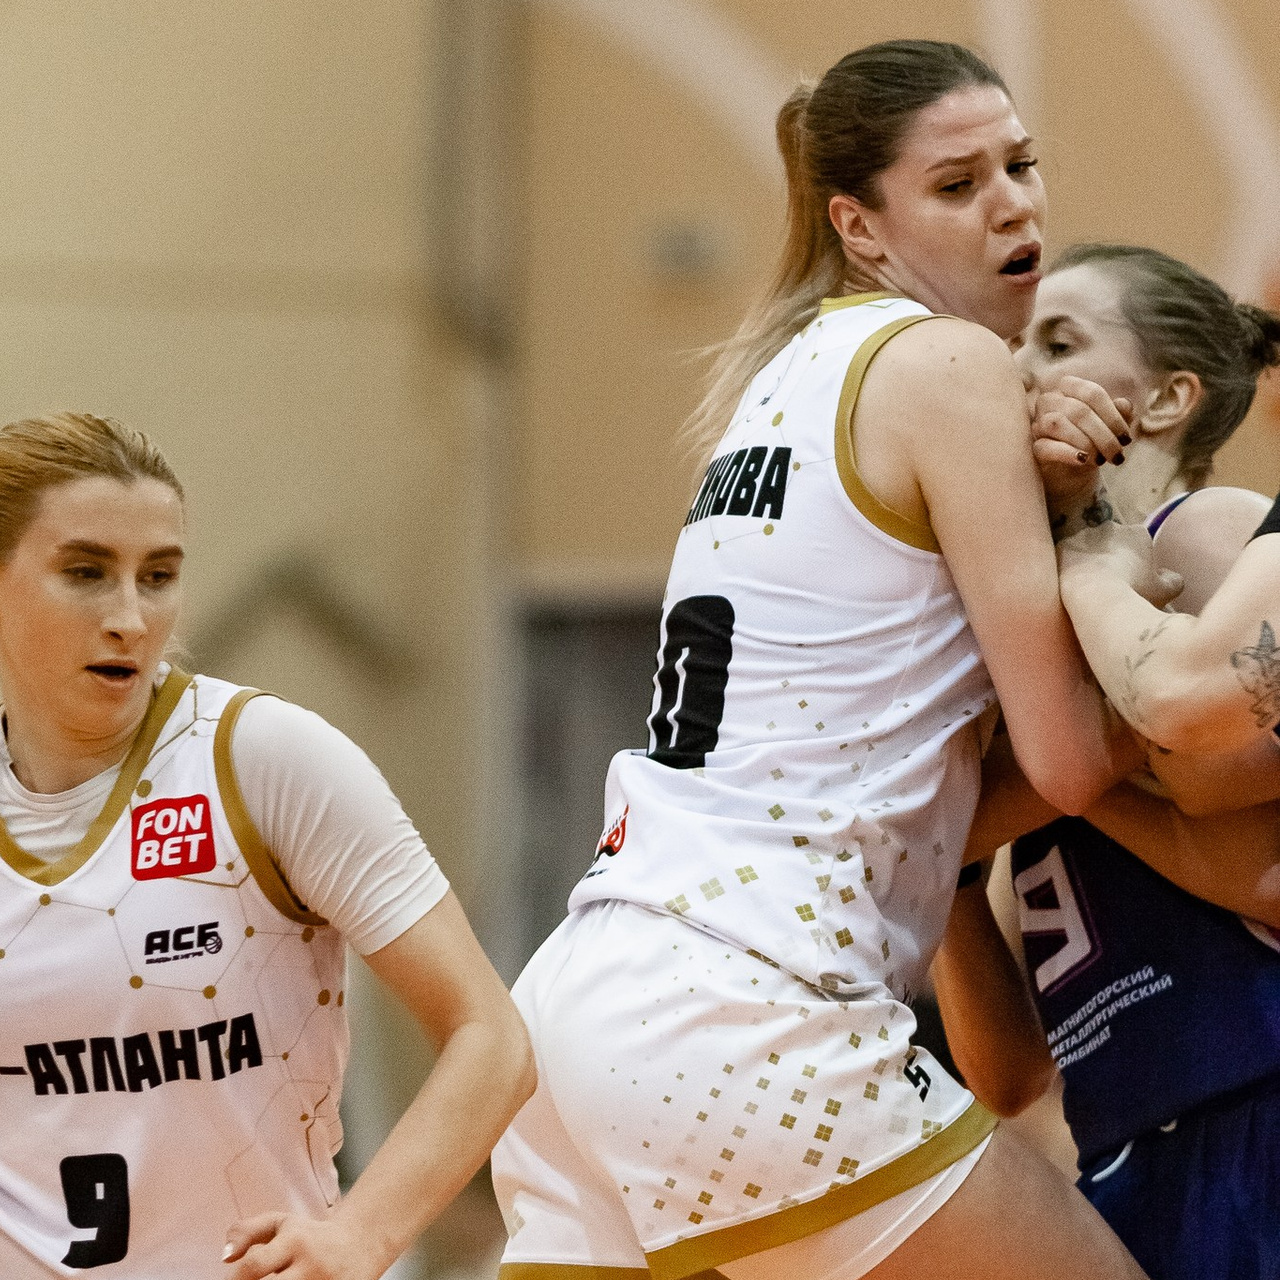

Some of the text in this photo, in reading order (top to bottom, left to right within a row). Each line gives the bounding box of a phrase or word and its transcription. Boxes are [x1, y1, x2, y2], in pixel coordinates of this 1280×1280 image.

[136, 803, 205, 841] FON
[136, 832, 208, 871] BET
[1047, 964, 1155, 1046] МАГНИТОГОРСКИЙ
[1050, 974, 1173, 1060] МЕТАЛЛУРГИЧЕСКИЙ
[1055, 1025, 1112, 1070] ОМБИНАТ
[60, 1153, 130, 1269] 9
